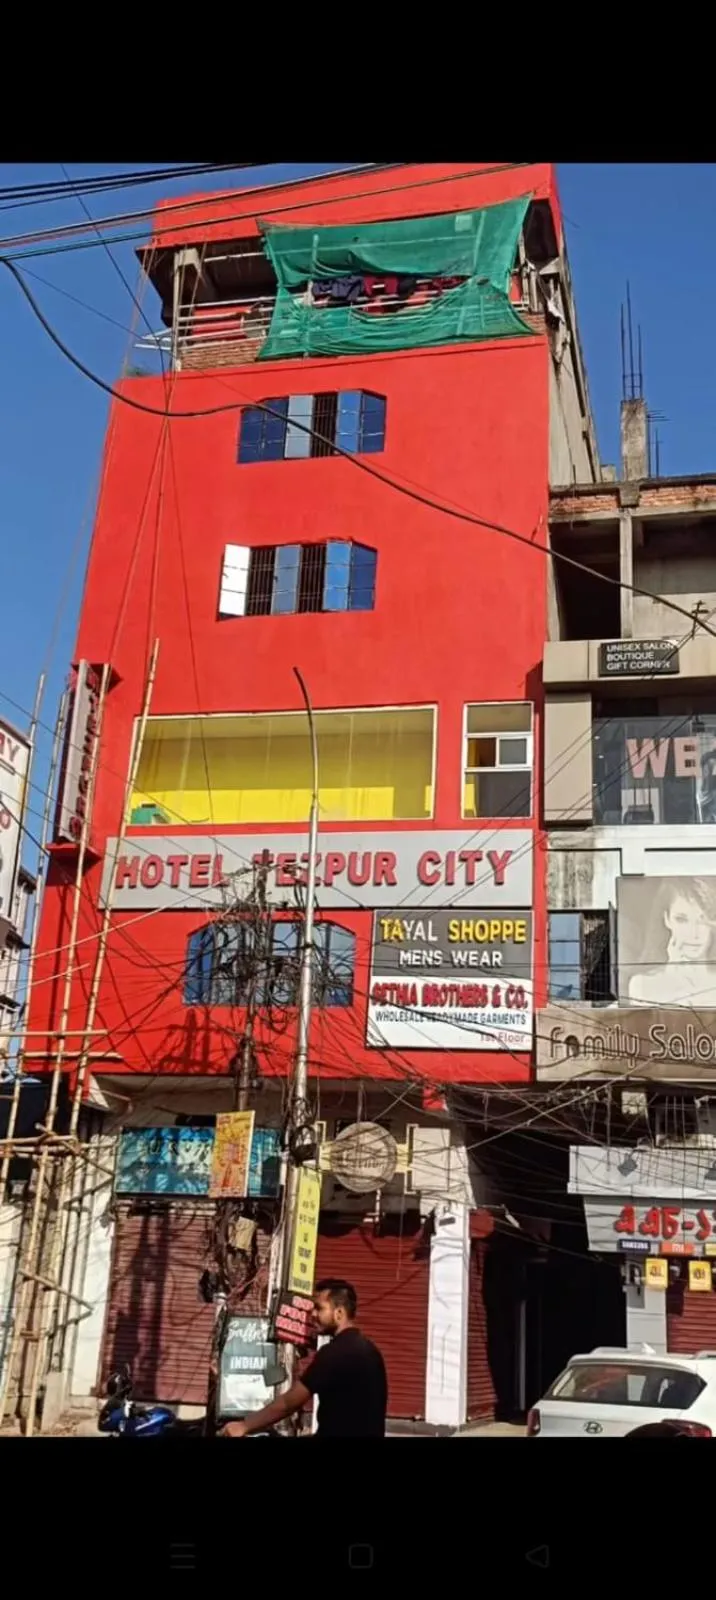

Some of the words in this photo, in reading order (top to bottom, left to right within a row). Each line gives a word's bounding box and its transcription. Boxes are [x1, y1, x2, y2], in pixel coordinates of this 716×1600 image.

[606, 643, 641, 653] UNISEX
[606, 651, 655, 662] BOUTIQUE
[606, 661, 628, 671] GIFT
[115, 854, 229, 889] HOTEL
[416, 850, 513, 887] CITY
[380, 918, 438, 943] TAYAL
[448, 918, 527, 943] SHOPPE
[400, 949, 443, 967] MENS
[450, 950, 503, 968] WEAR
[421, 983, 488, 1008] BROTHERS
[375, 1010, 424, 1024] WHOLESALE
[480, 1012, 526, 1025] GARMENTS
[649, 1023, 716, 1060] Salo
